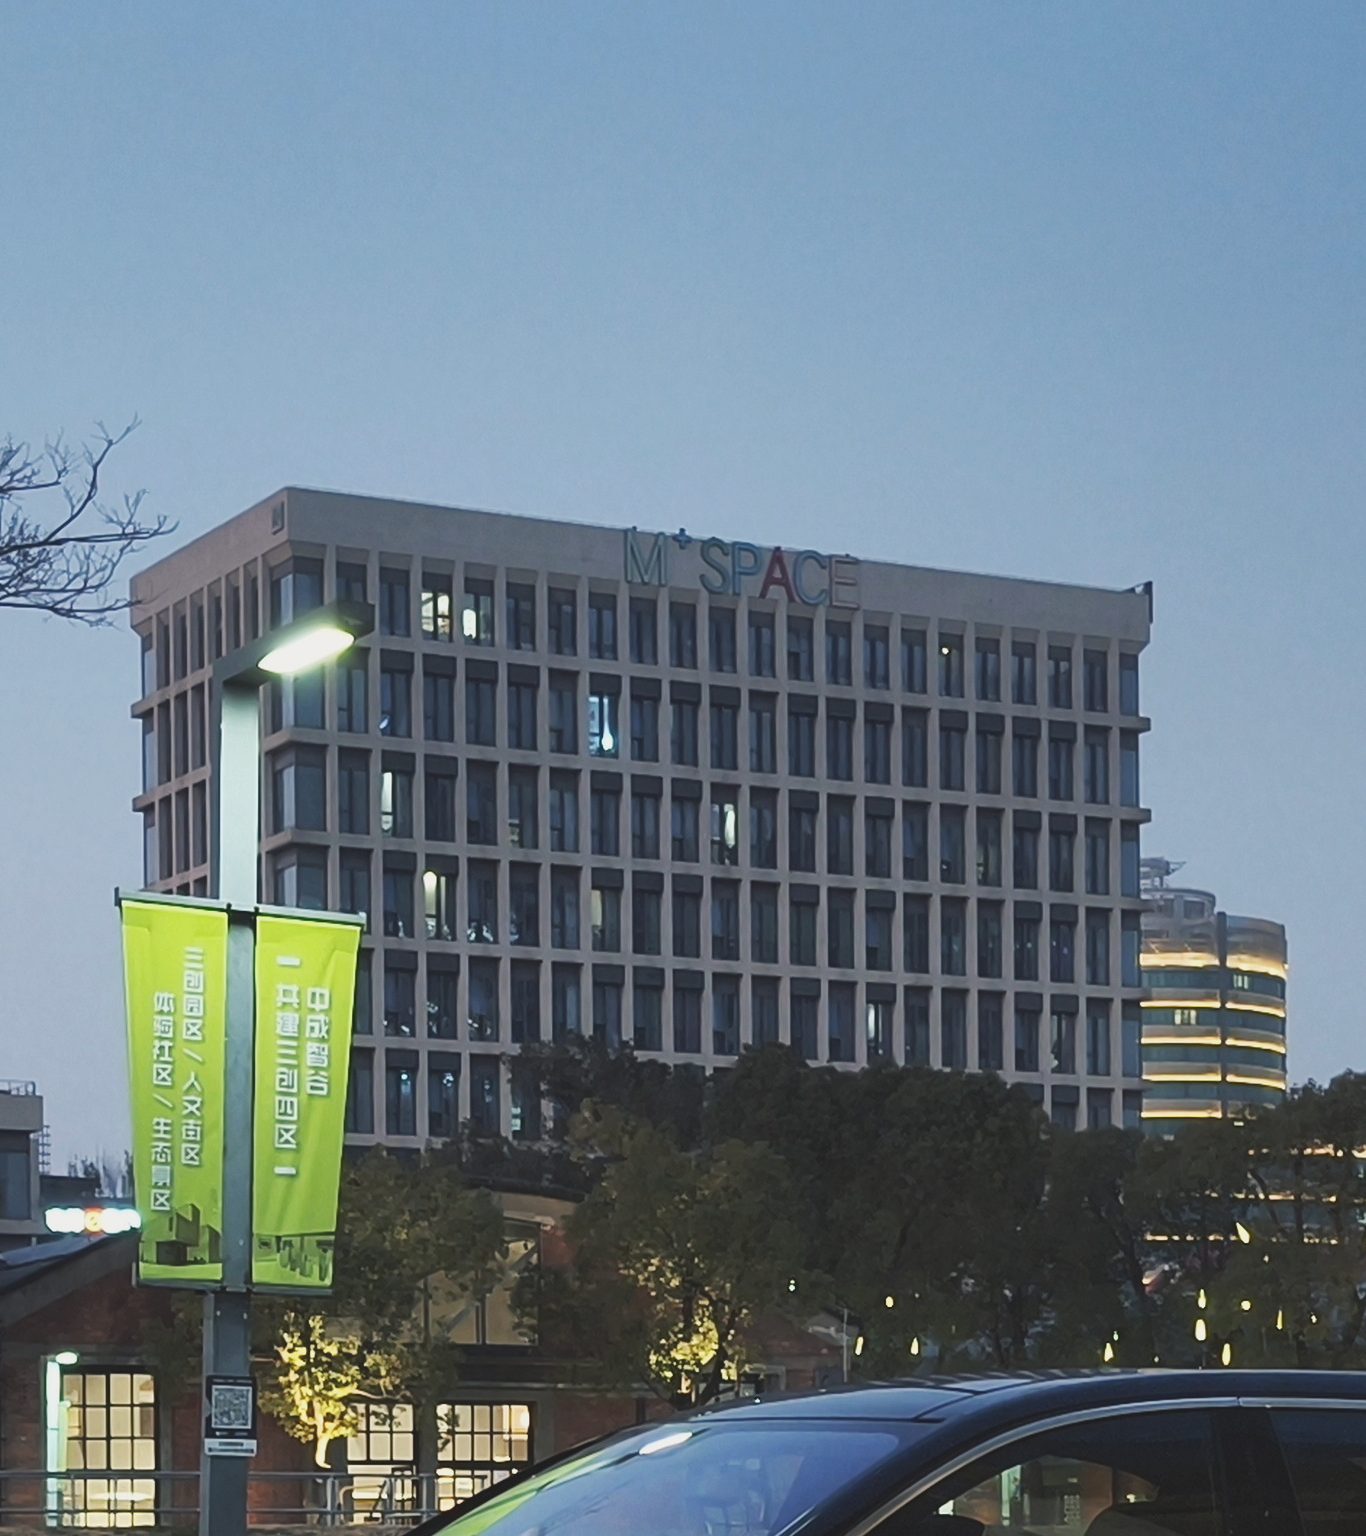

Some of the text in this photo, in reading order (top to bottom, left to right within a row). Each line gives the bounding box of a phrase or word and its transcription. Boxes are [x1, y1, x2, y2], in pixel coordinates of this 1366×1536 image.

[699, 536, 860, 610] SPACE
[305, 986, 330, 1096] 中成智谷
